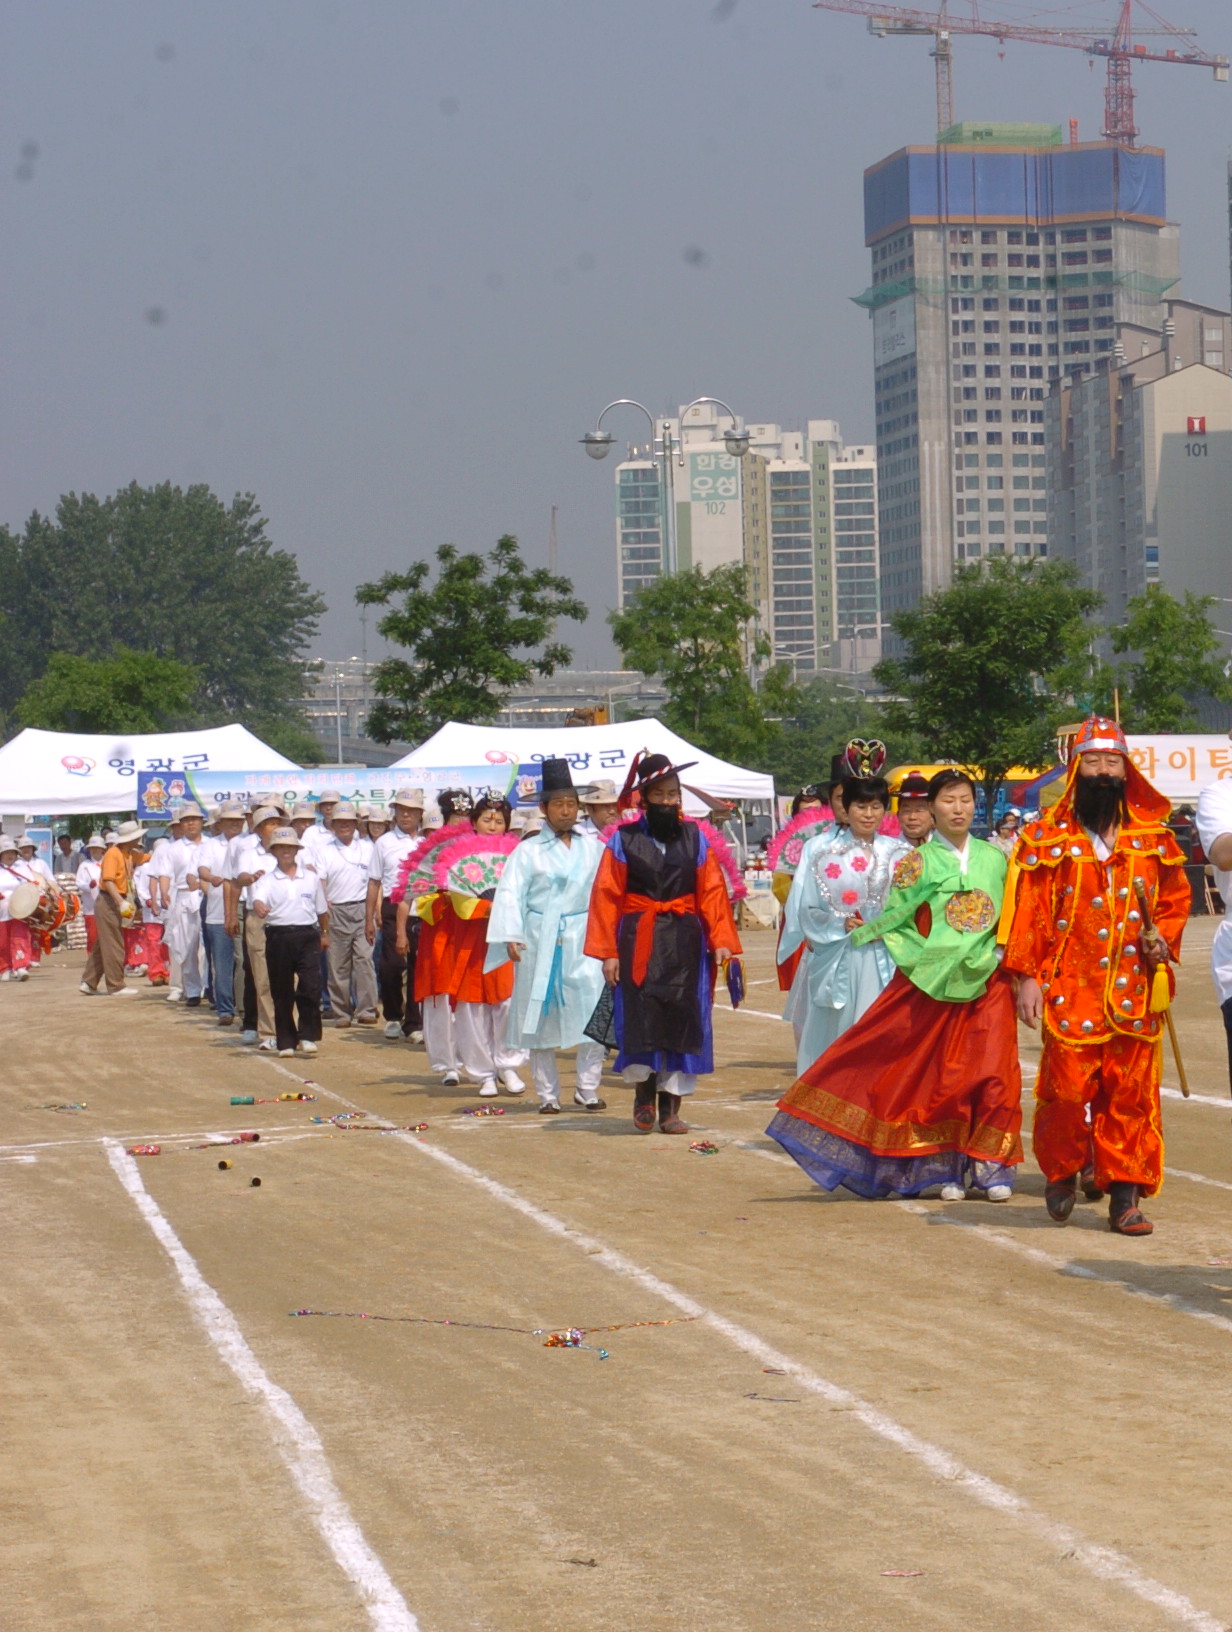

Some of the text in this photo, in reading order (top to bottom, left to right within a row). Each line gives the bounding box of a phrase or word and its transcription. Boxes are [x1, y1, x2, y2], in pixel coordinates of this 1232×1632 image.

[1184, 443, 1208, 457] 101
[692, 477, 738, 497] 우성
[705, 502, 726, 515] 102
[108, 754, 209, 776] 영광군
